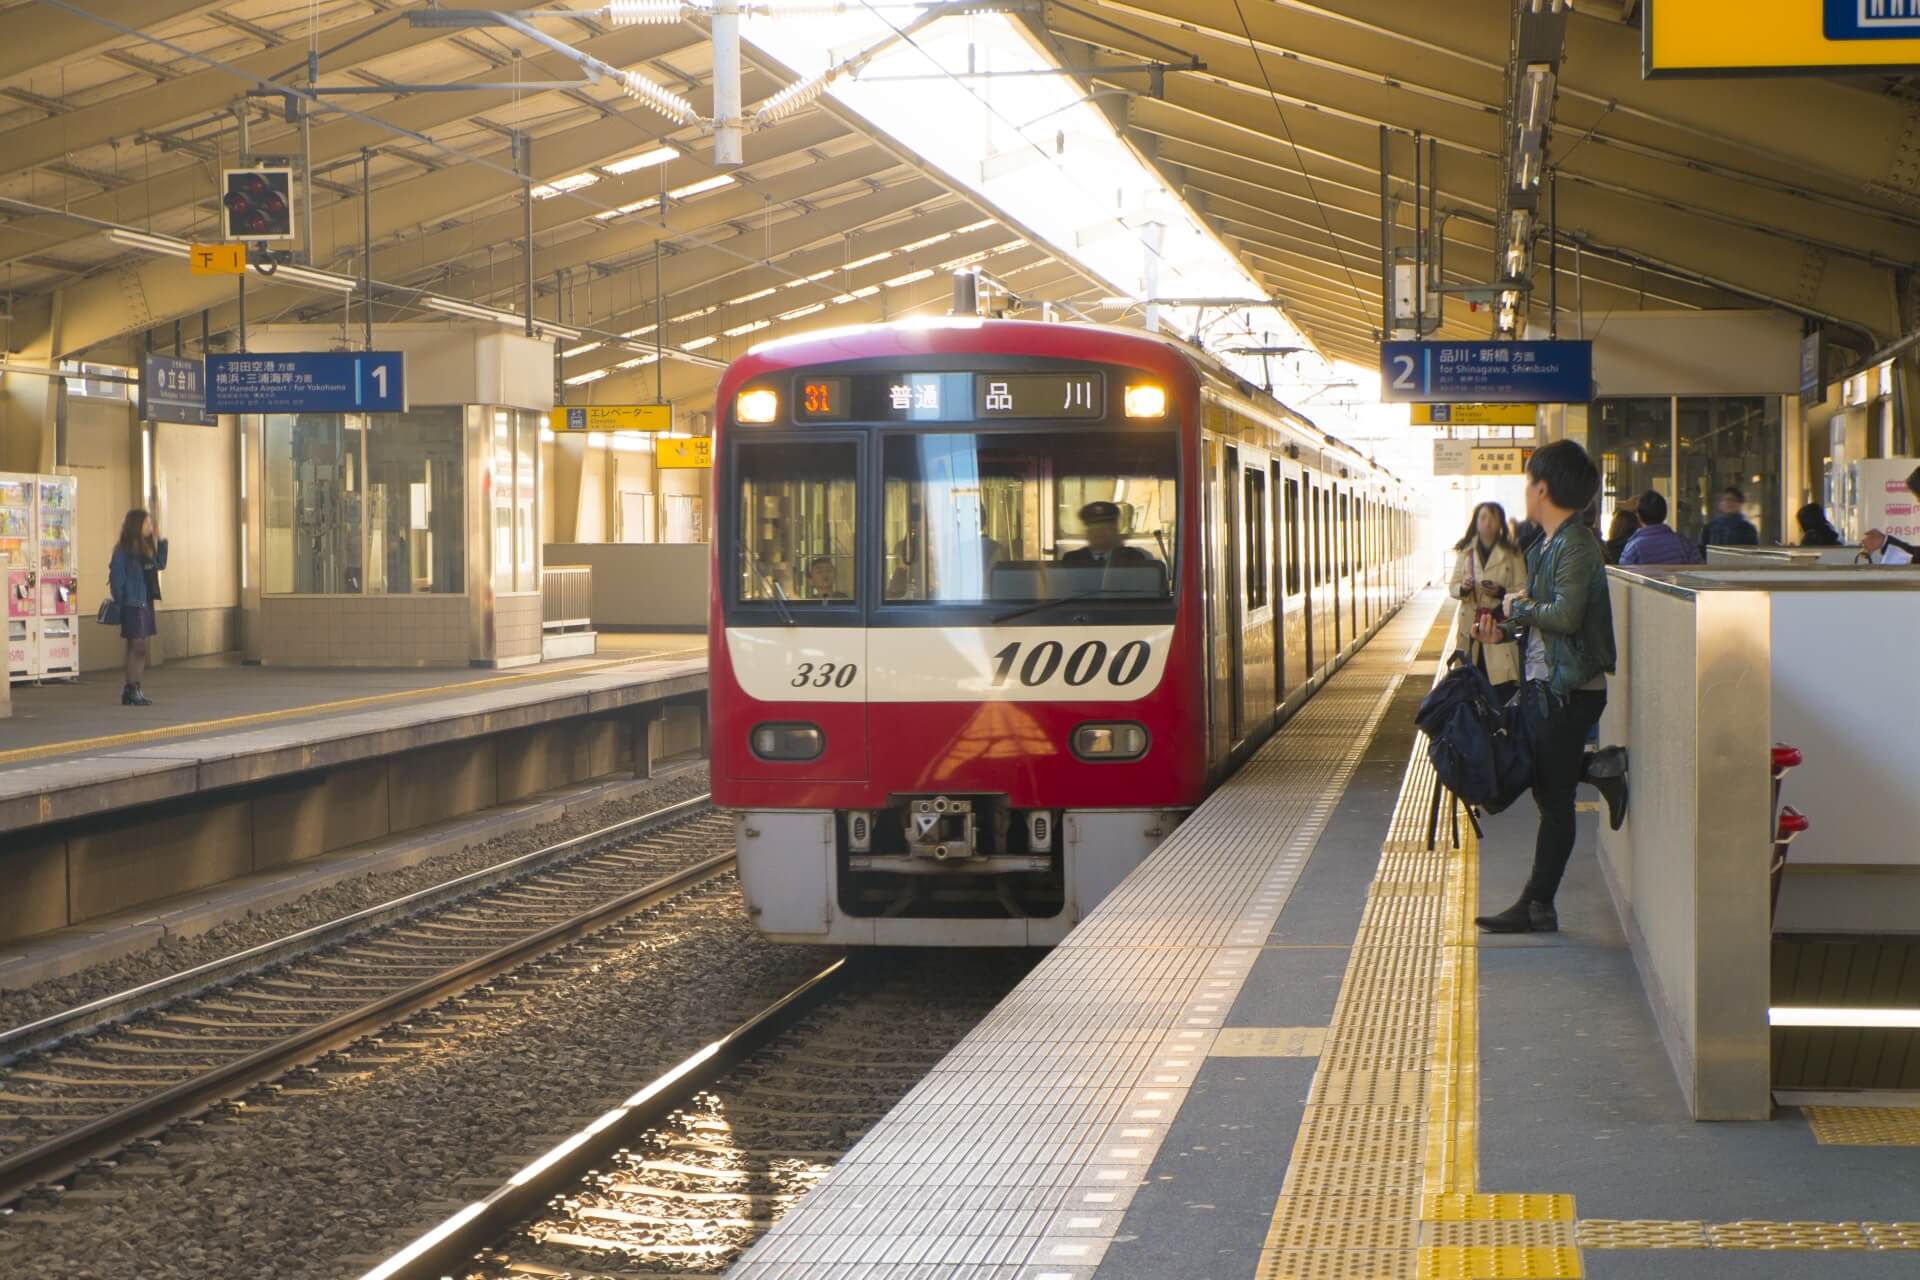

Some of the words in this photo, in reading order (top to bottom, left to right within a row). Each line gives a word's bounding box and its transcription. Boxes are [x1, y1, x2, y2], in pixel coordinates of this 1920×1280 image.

[168, 368, 196, 392] 立会川
[371, 365, 387, 398] 1
[1392, 355, 1416, 389] 2
[1440, 364, 1453, 373] for
[1456, 364, 1509, 375] Shinagawa,
[1512, 364, 1559, 373] Shimbashi
[260, 384, 287, 393] Airport
[804, 384, 830, 412] 31
[889, 384, 939, 410] 普通
[590, 408, 654, 417] エレベーター
[791, 663, 858, 689] 330
[992, 640, 1152, 688] 1000
